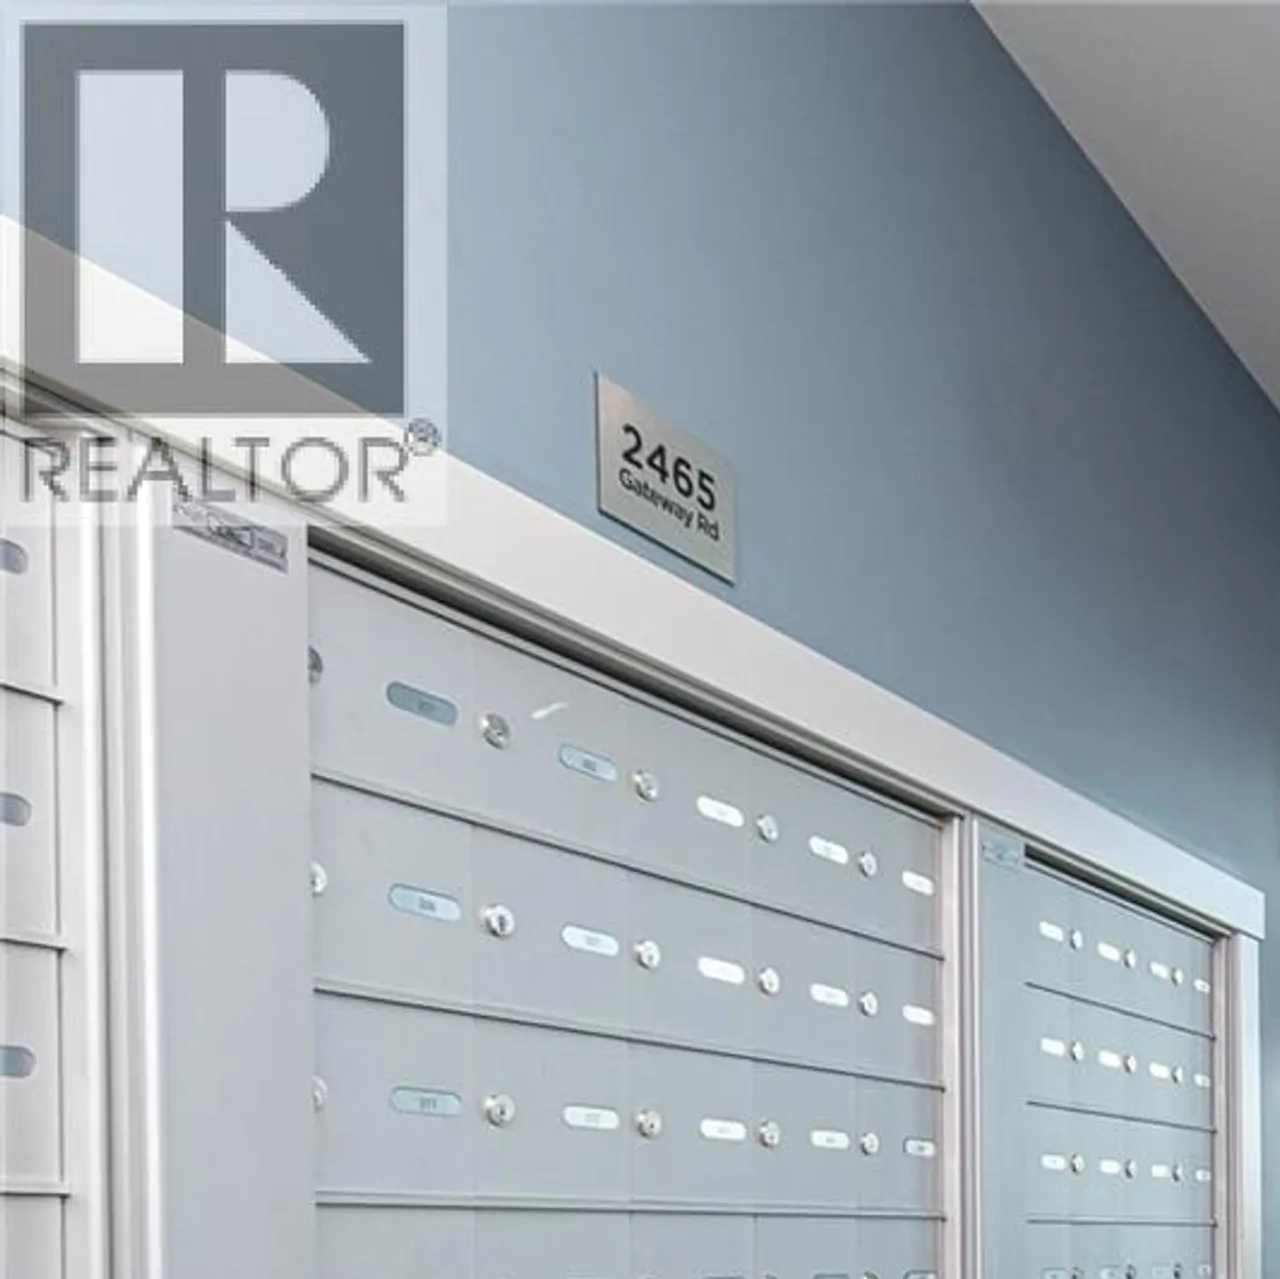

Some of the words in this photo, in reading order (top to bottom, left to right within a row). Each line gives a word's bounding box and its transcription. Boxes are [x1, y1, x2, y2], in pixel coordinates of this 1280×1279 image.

[618, 467, 695, 530] Gateway
[696, 513, 720, 542] Rd
[621, 422, 716, 512] 2465
